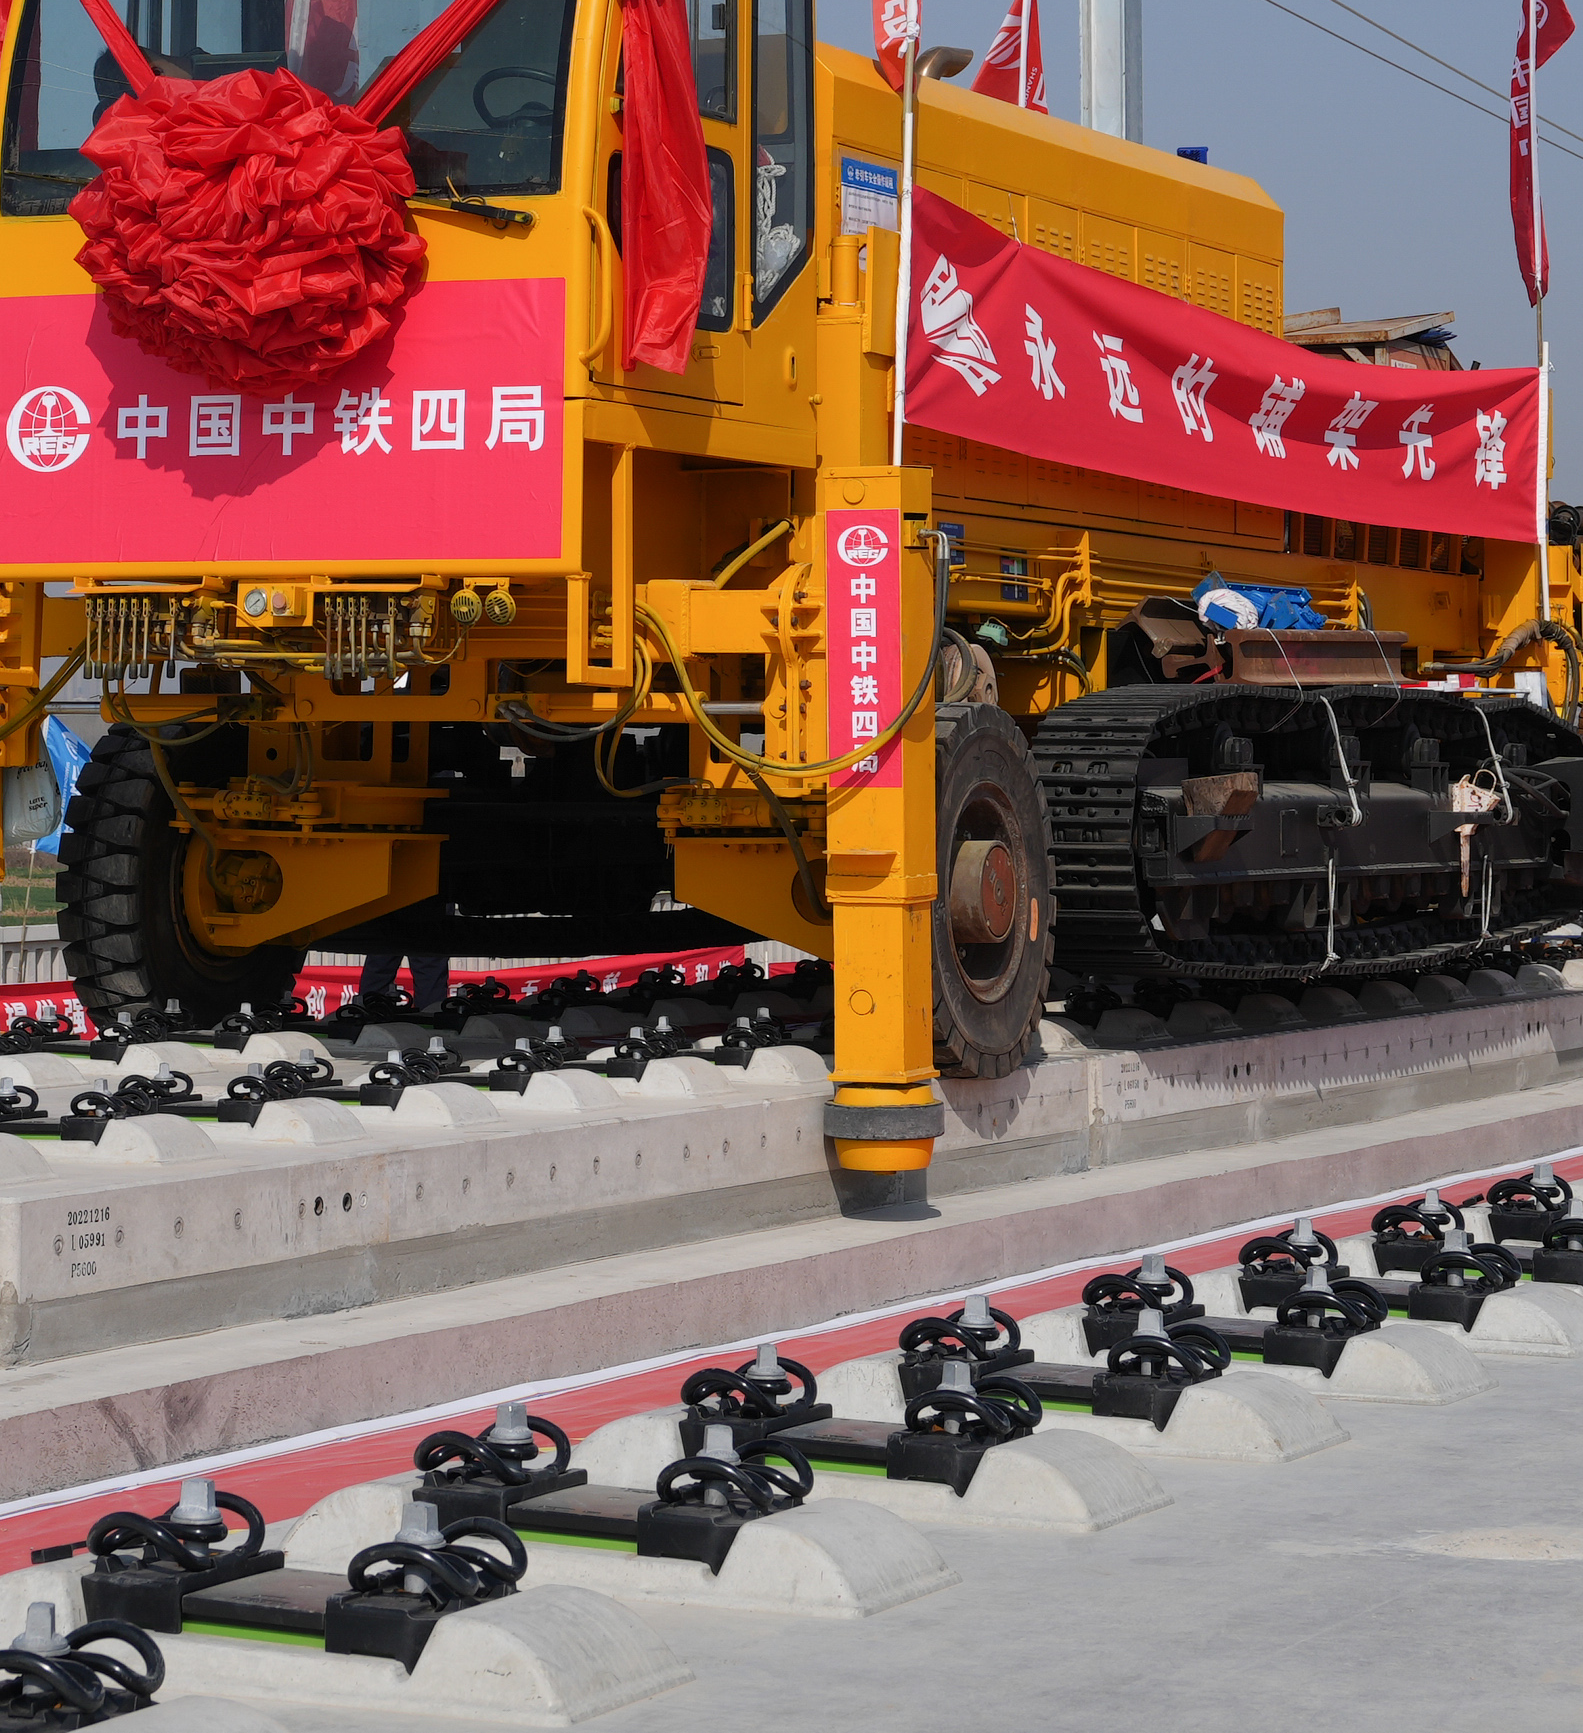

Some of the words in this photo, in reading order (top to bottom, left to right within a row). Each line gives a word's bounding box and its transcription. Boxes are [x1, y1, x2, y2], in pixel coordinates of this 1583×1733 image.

[1023, 302, 1508, 490] 永远的铺架先锋
[117, 385, 545, 460] 中国中铁四局
[850, 573, 879, 774] 中国中铁四局
[67, 1206, 110, 1226] 20221216
[78, 1232, 105, 1250] 05991
[70, 1261, 97, 1278] P5600
